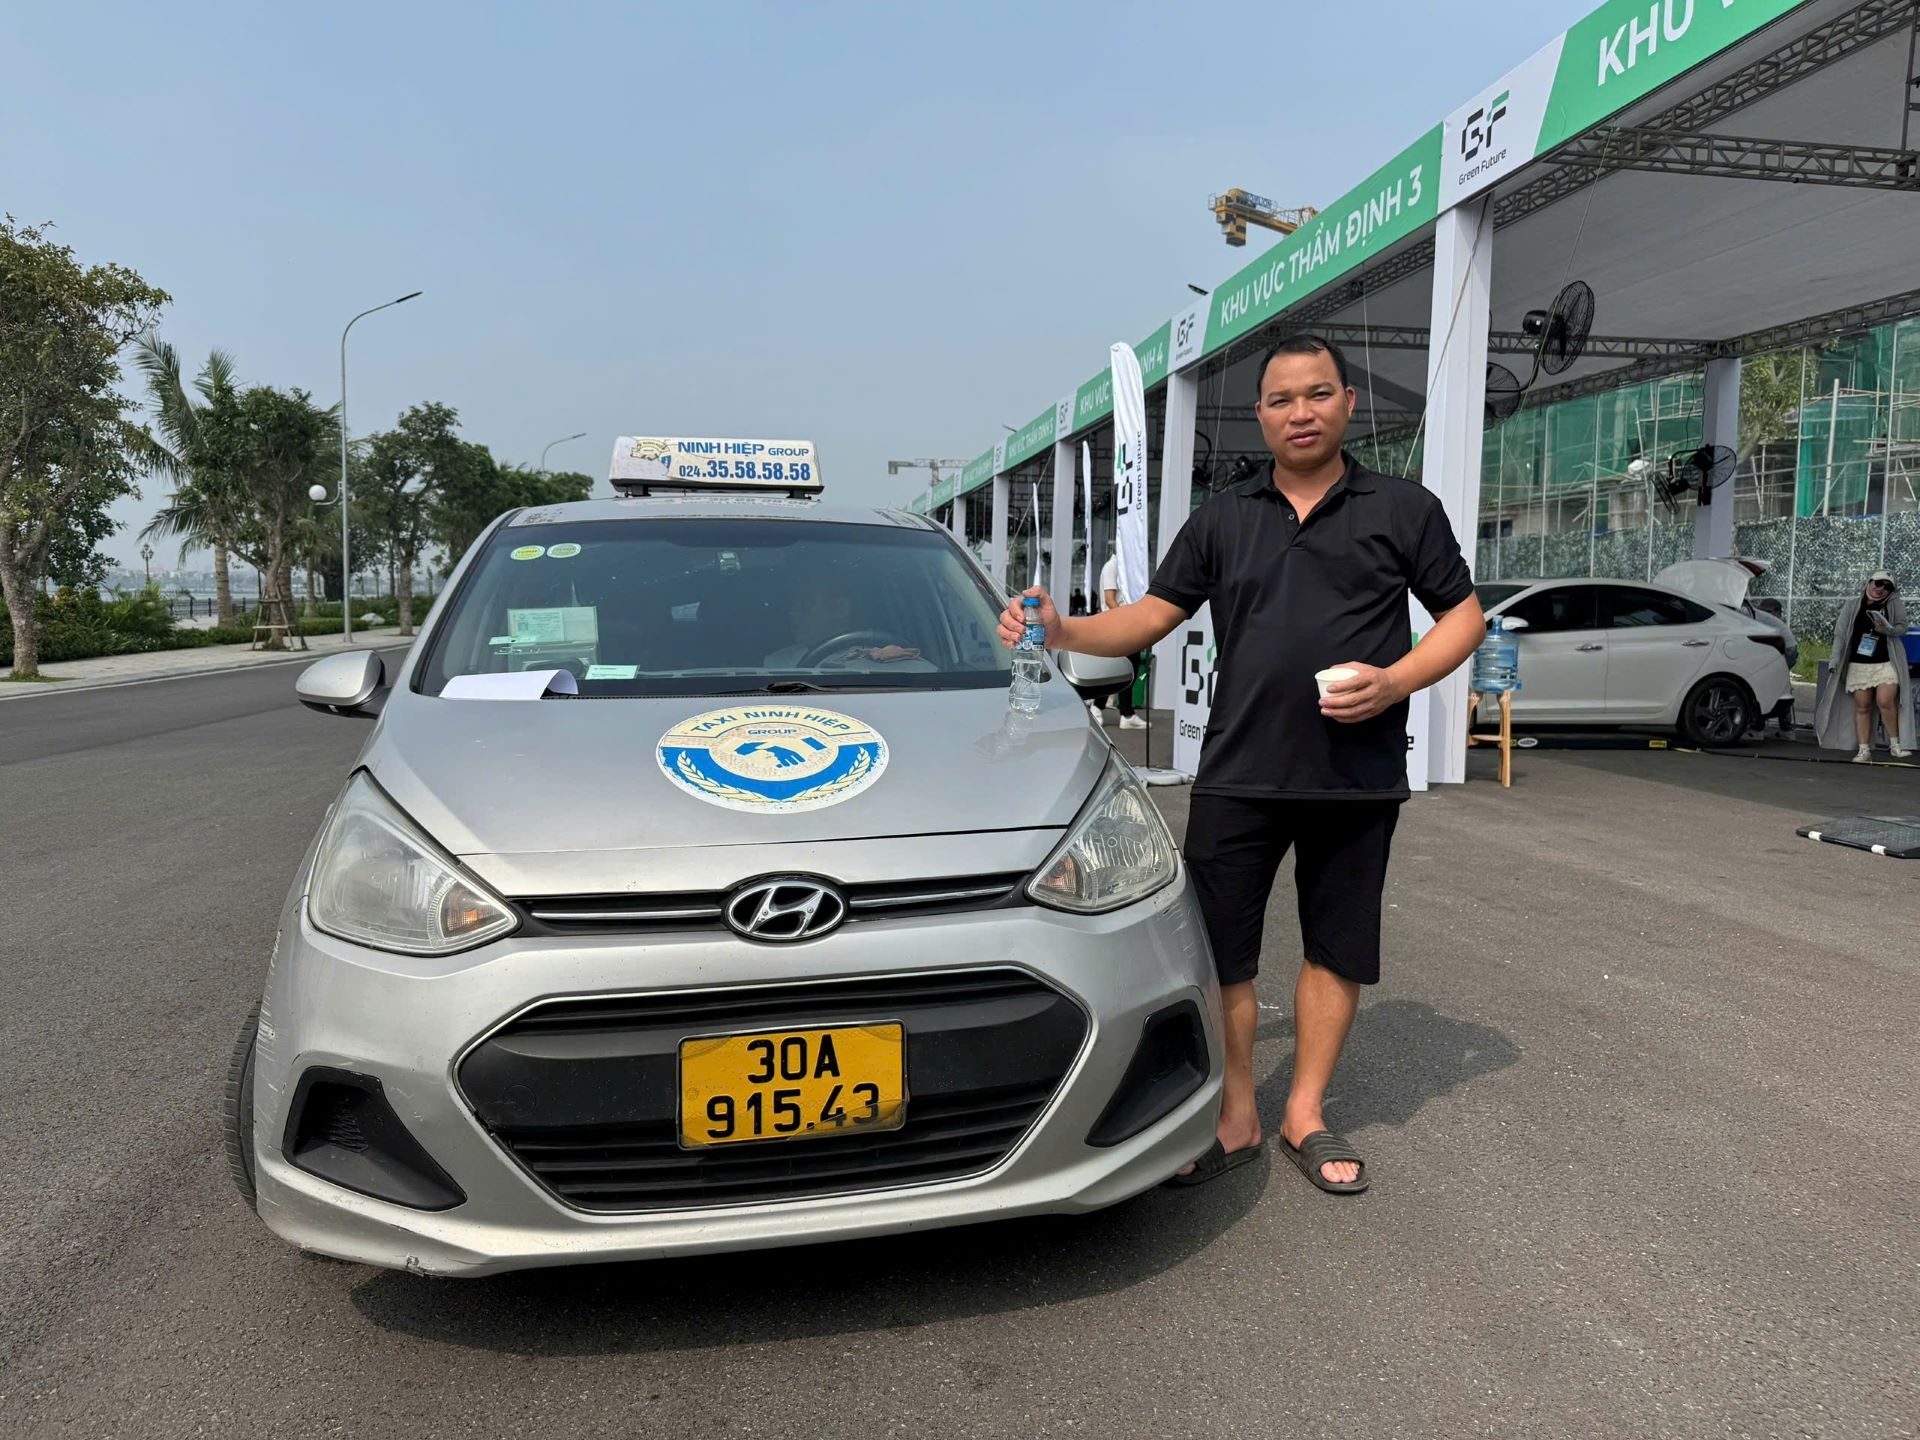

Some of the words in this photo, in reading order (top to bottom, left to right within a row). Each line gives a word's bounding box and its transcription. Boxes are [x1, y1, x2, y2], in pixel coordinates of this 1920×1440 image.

[1597, 0, 1695, 87] KHU
[1458, 166, 1480, 185] Green
[1480, 148, 1507, 174] Future
[1221, 283, 1250, 328] KHU
[1253, 260, 1285, 308] VỰC
[1288, 221, 1341, 284] THẨM
[1345, 182, 1402, 248] ĐỊNH
[1406, 164, 1422, 207] 3
[1157, 342, 1163, 365] 4
[1080, 390, 1094, 417] KHU
[1095, 379, 1110, 409] VỰC
[677, 441, 721, 454] NINH
[724, 441, 765, 457] HIỆP
[768, 448, 809, 457] GROUP
[690, 714, 738, 733] TAXI
[744, 710, 800, 719] NINH
[803, 713, 851, 731] HIỆP
[1179, 720, 1201, 741] Green
[746, 1033, 841, 1085] 30A
[706, 1082, 881, 1139] 915.43
